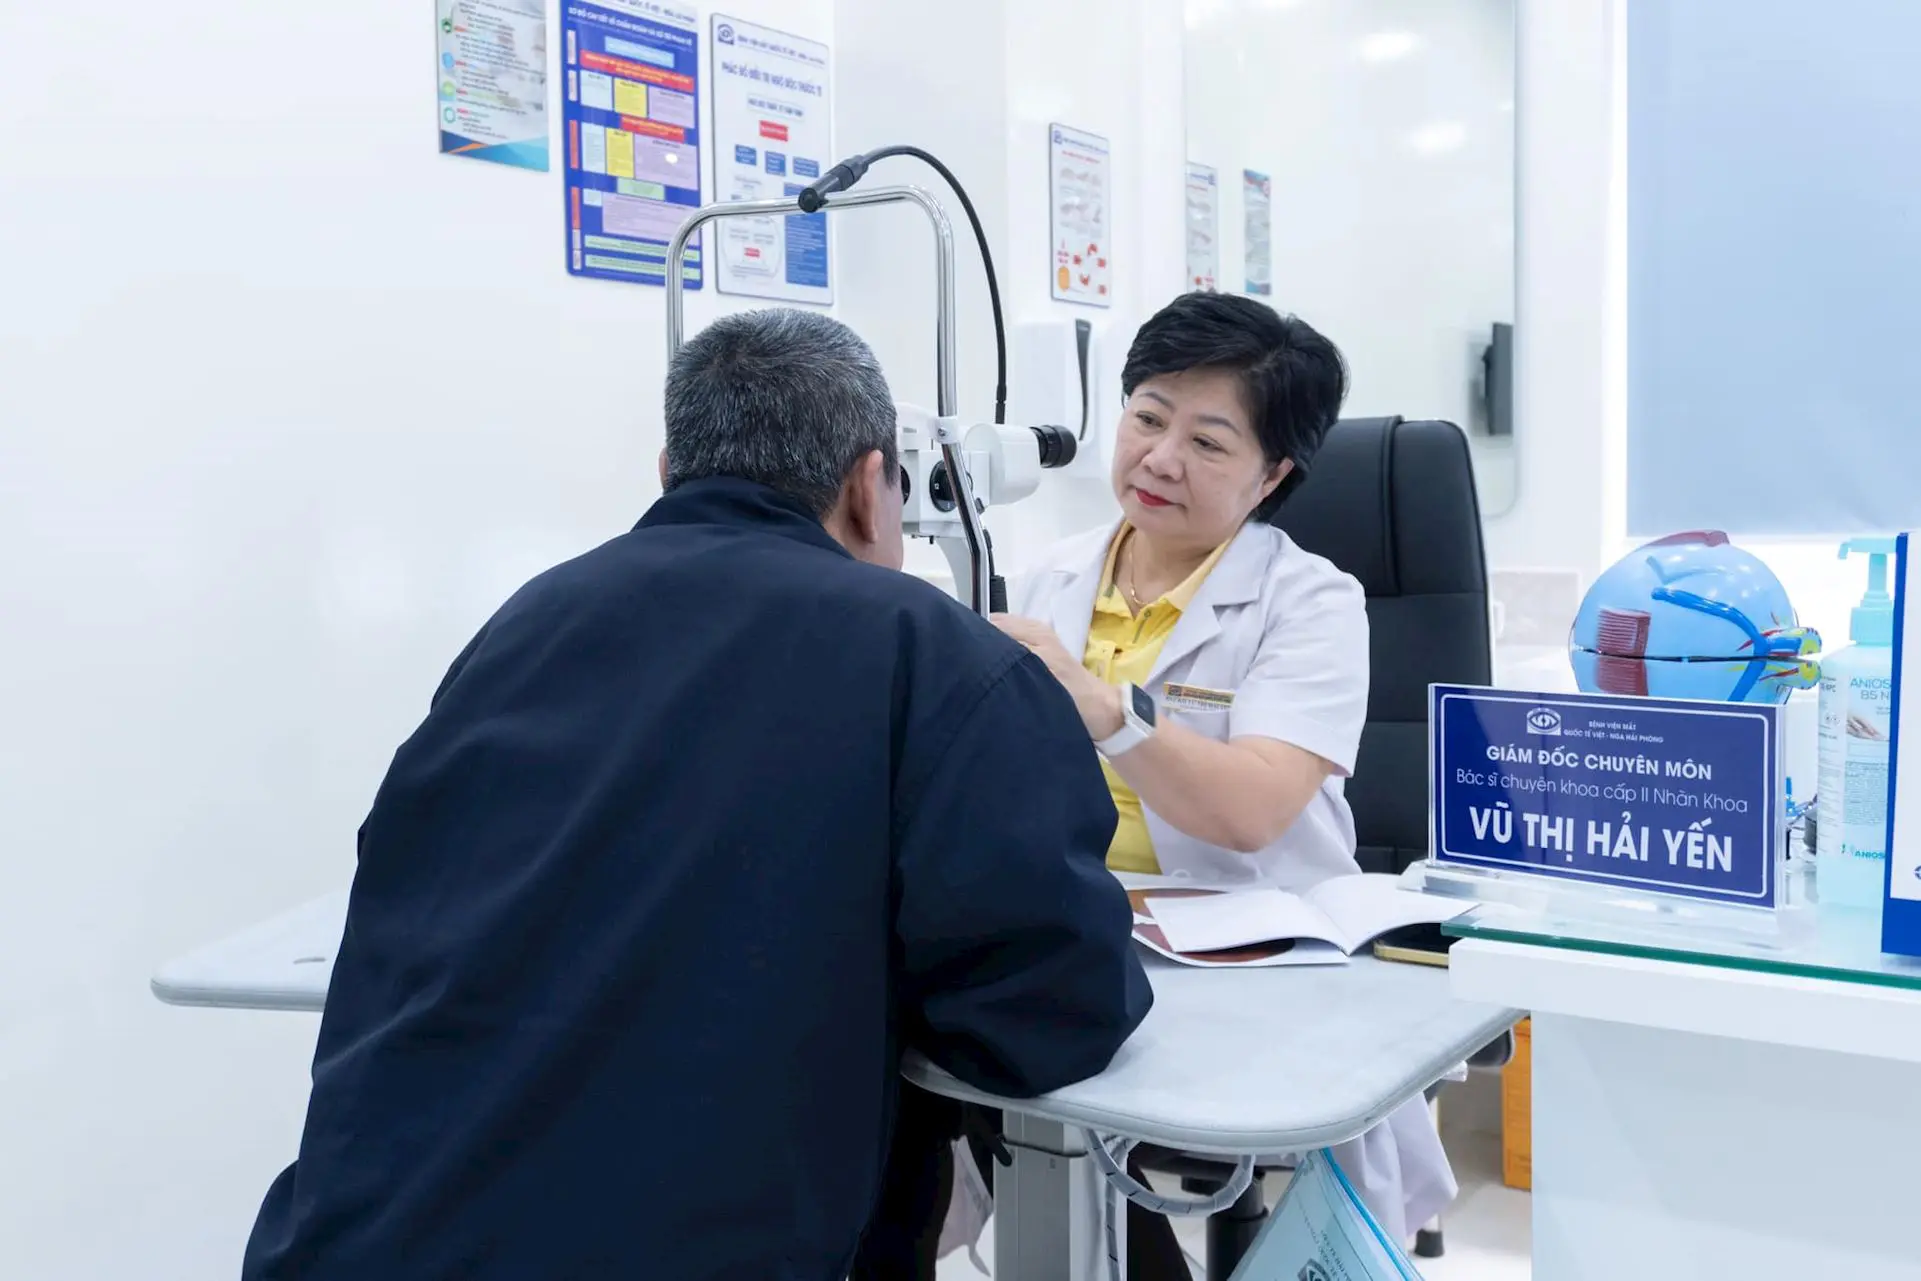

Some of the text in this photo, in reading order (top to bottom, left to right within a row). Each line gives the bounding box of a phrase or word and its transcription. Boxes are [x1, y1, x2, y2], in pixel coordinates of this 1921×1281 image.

[1609, 732, 1624, 741] NGA
[1486, 743, 1712, 780] GIÁM ĐỐC CHUYÊN MÔN
[1456, 768, 1485, 786] Bác
[1487, 771, 1498, 787] sĩ
[1500, 774, 1556, 795] chuyên
[1560, 779, 1599, 798] khoa
[1603, 783, 1637, 803] cấp
[1641, 787, 1649, 802] II
[1703, 792, 1749, 813] Khoa
[1469, 801, 1733, 872] VŨ THỊ HẢI YẾN
